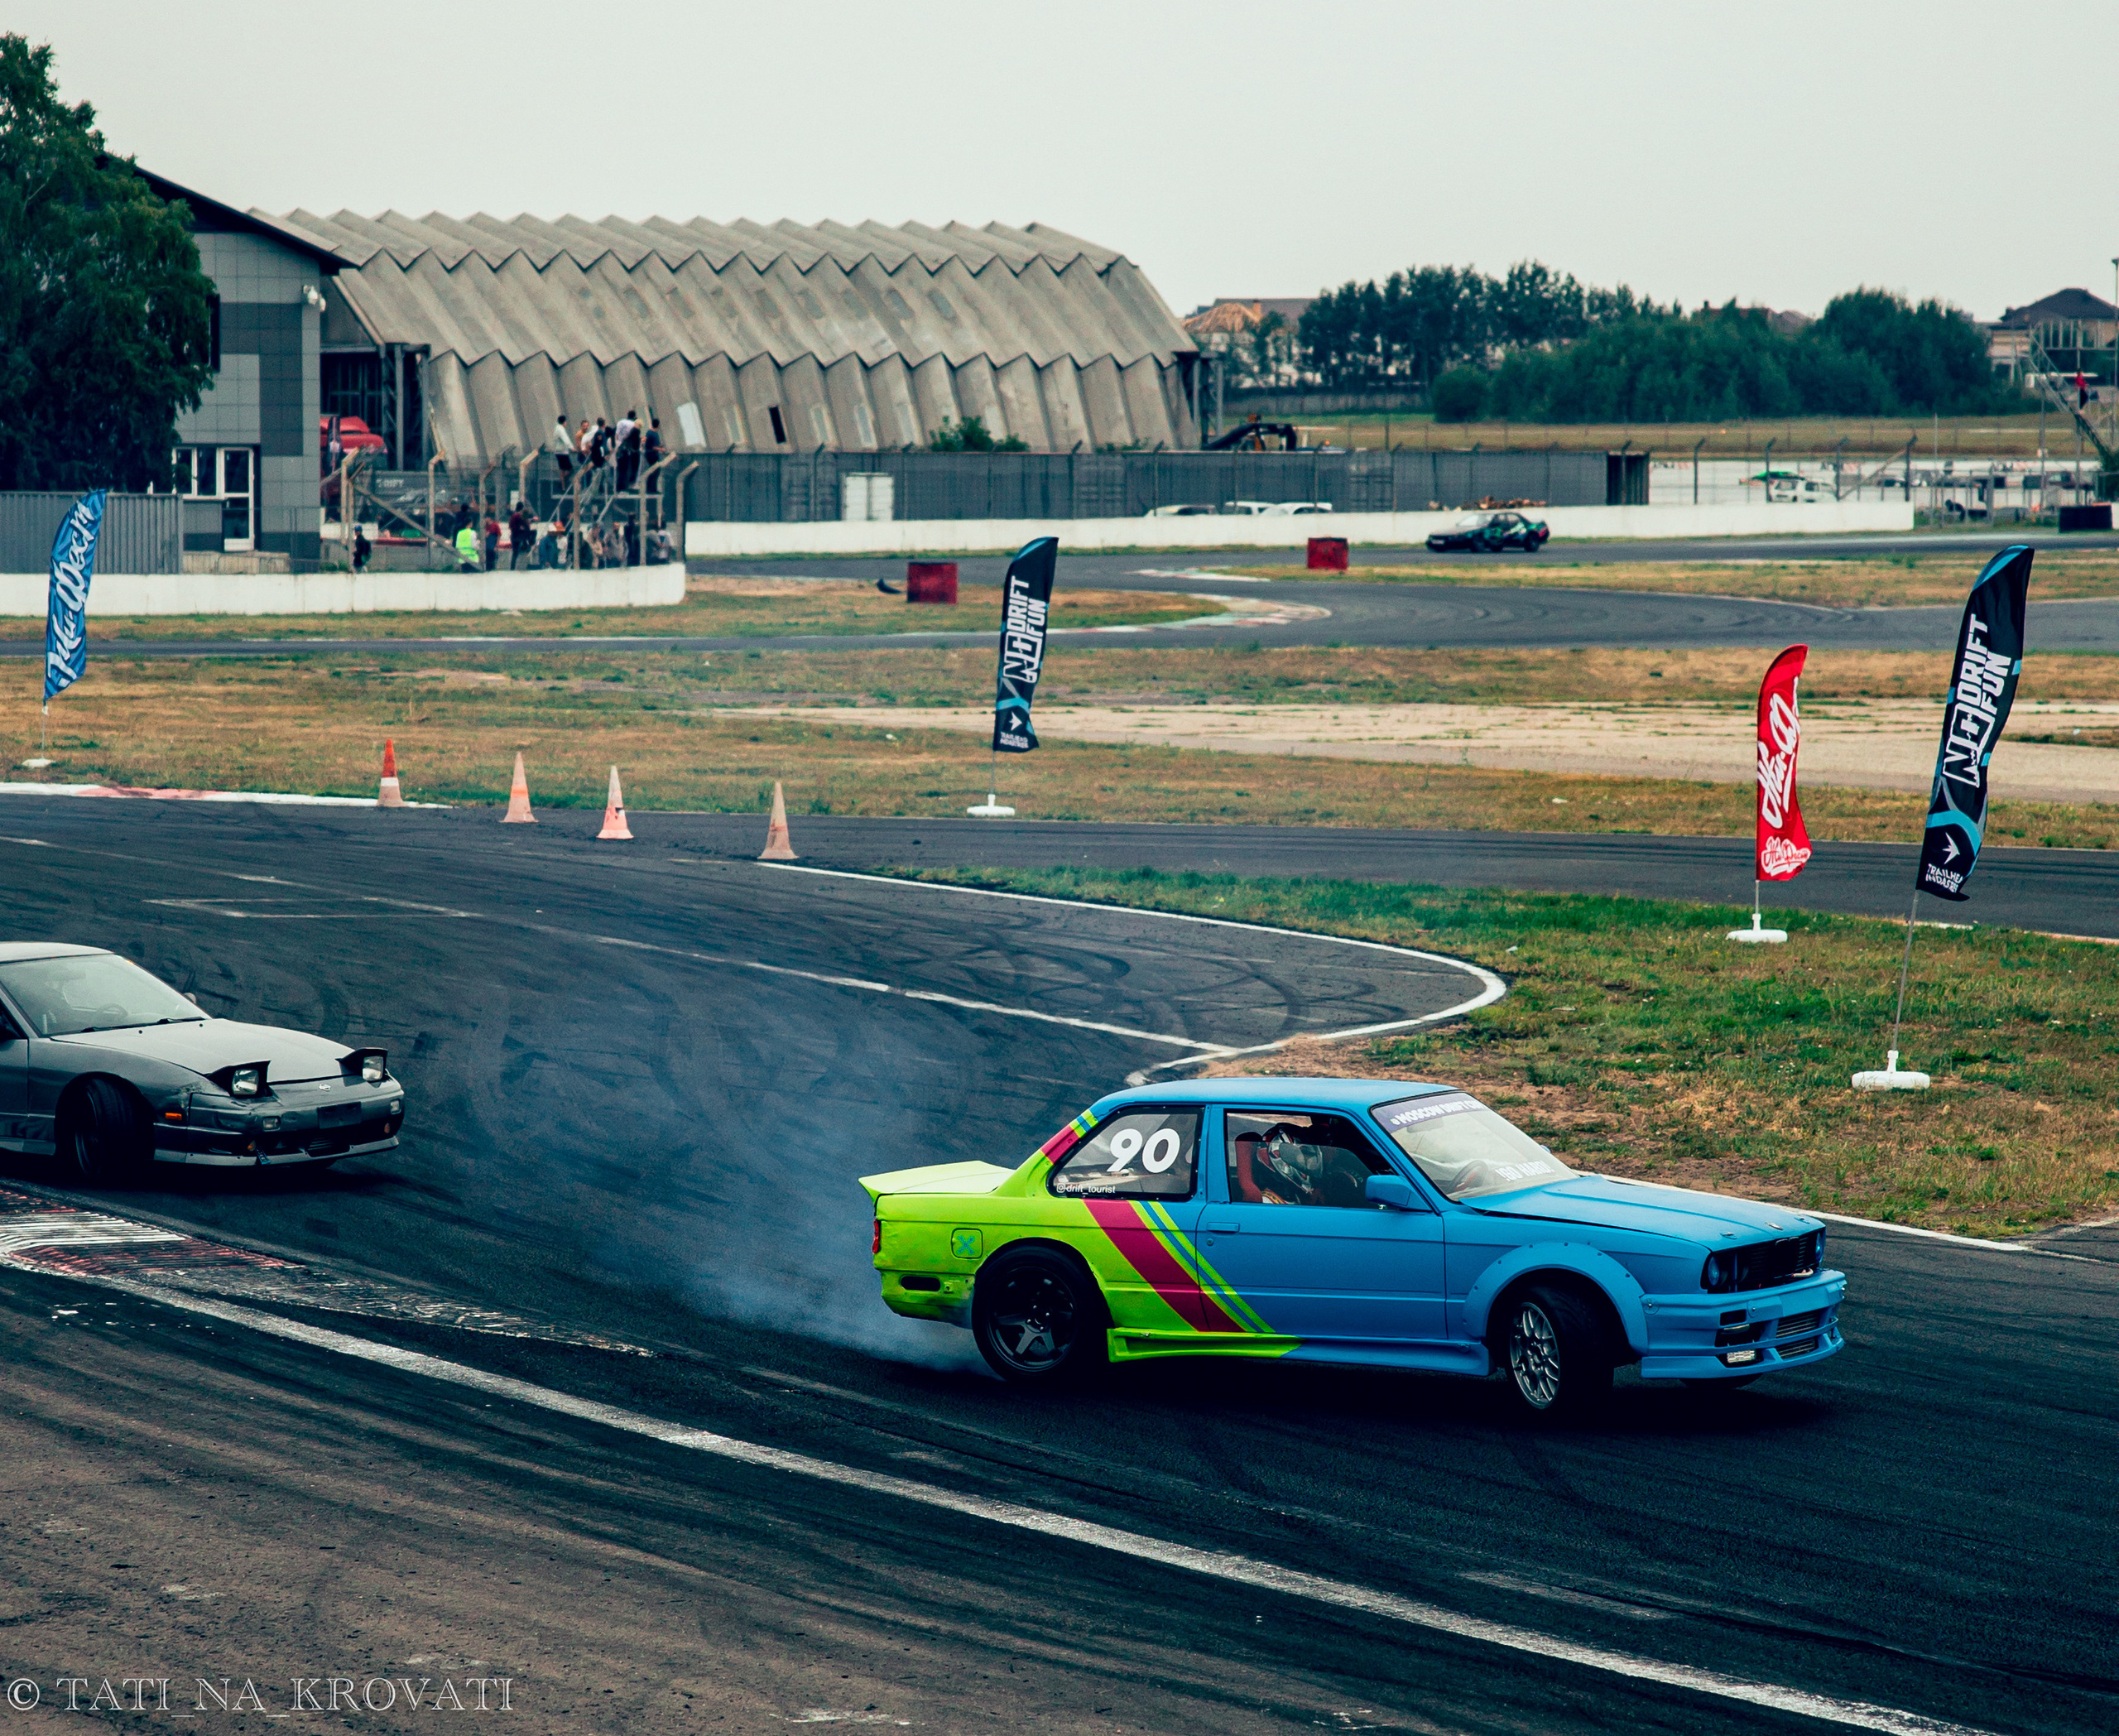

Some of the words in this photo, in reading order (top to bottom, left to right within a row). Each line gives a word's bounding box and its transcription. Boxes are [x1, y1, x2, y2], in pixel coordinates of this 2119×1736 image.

[1007, 575, 1030, 633] DRIFT
[1026, 598, 1046, 637] FUN
[1956, 613, 1988, 707] DRIFT
[1981, 651, 2011, 715] FUN
[1395, 1104, 1445, 1123] MOSCOW
[1106, 1128, 1180, 1173] 90
